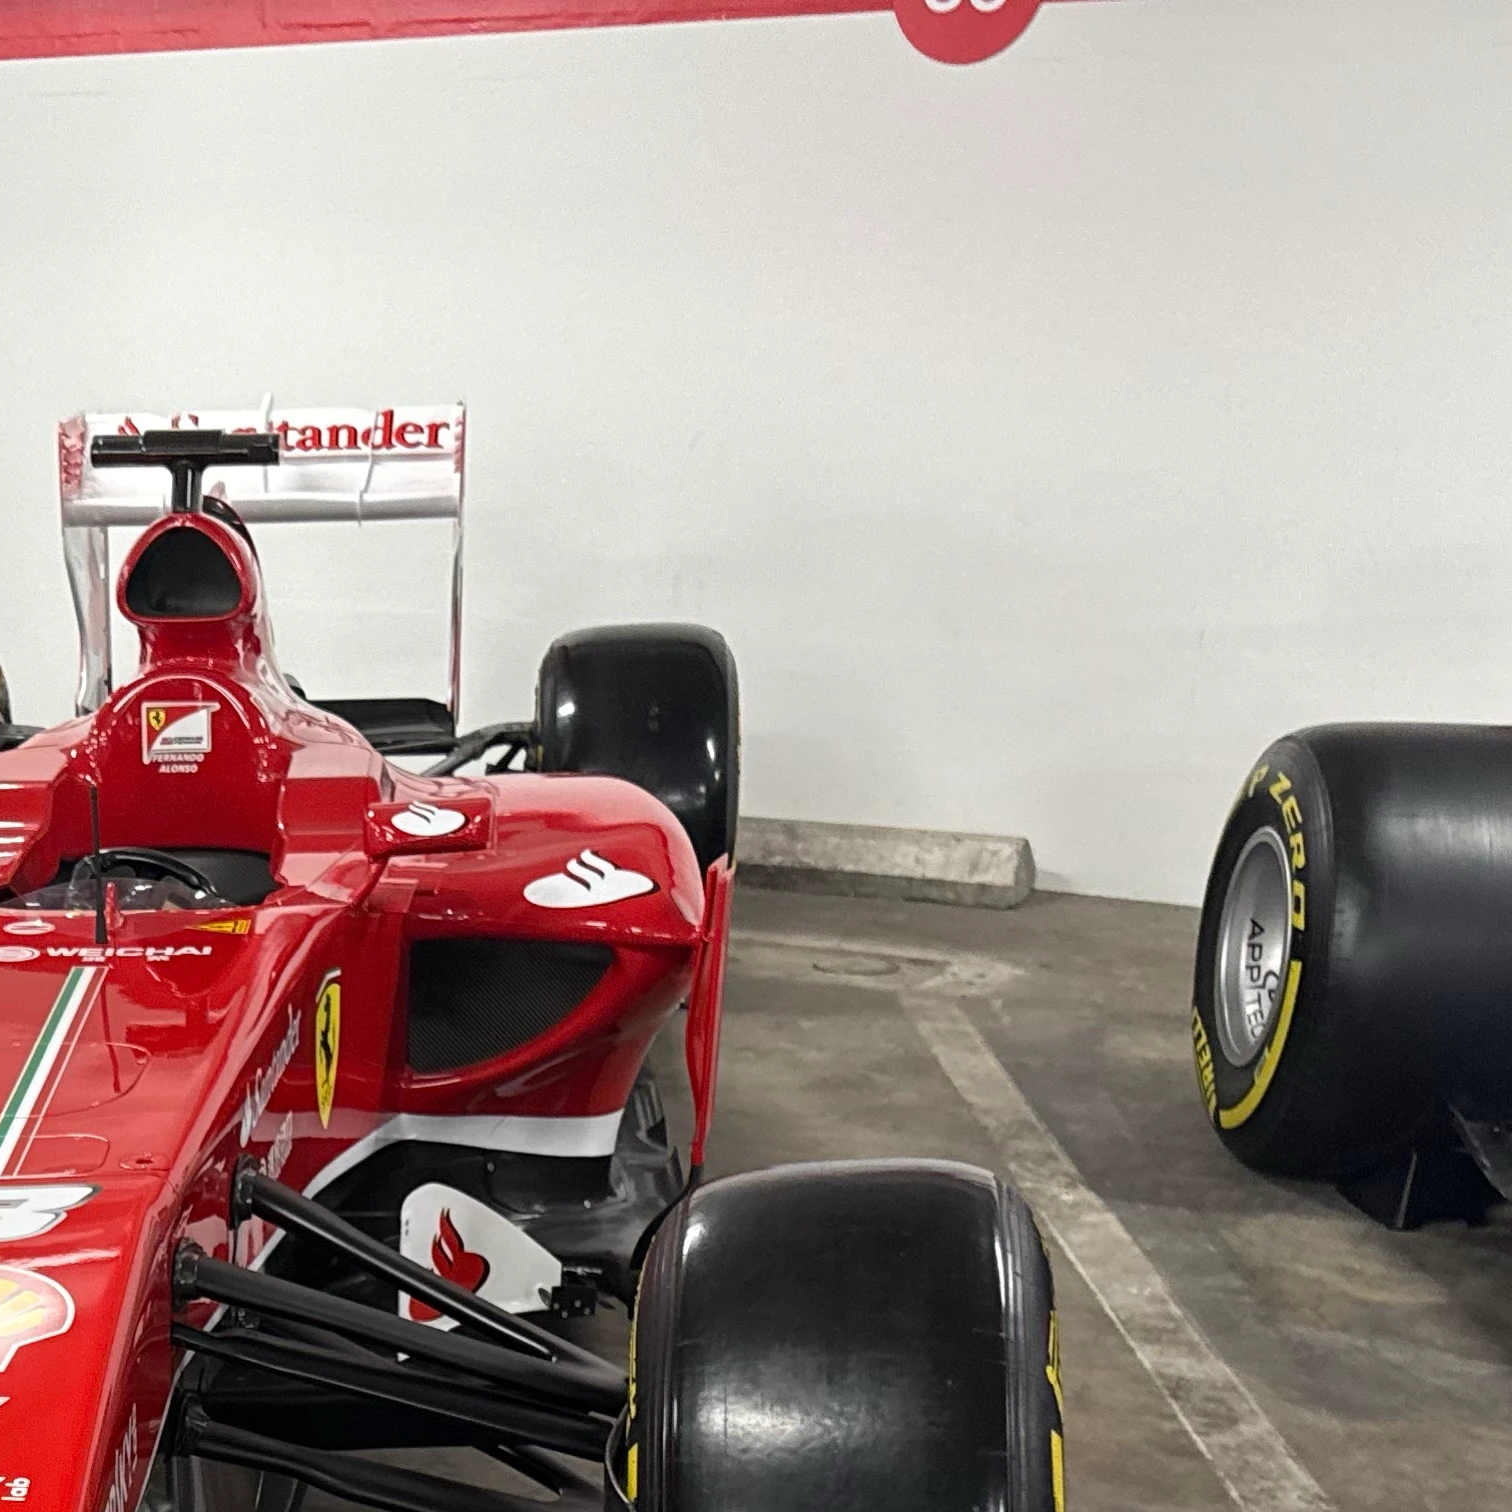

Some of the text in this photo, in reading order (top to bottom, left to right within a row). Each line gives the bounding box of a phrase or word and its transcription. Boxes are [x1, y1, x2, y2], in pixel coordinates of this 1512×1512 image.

[171, 408, 451, 451] tander
[1268, 770, 1306, 932] ZERO
[46, 945, 213, 958] WEICHAI
